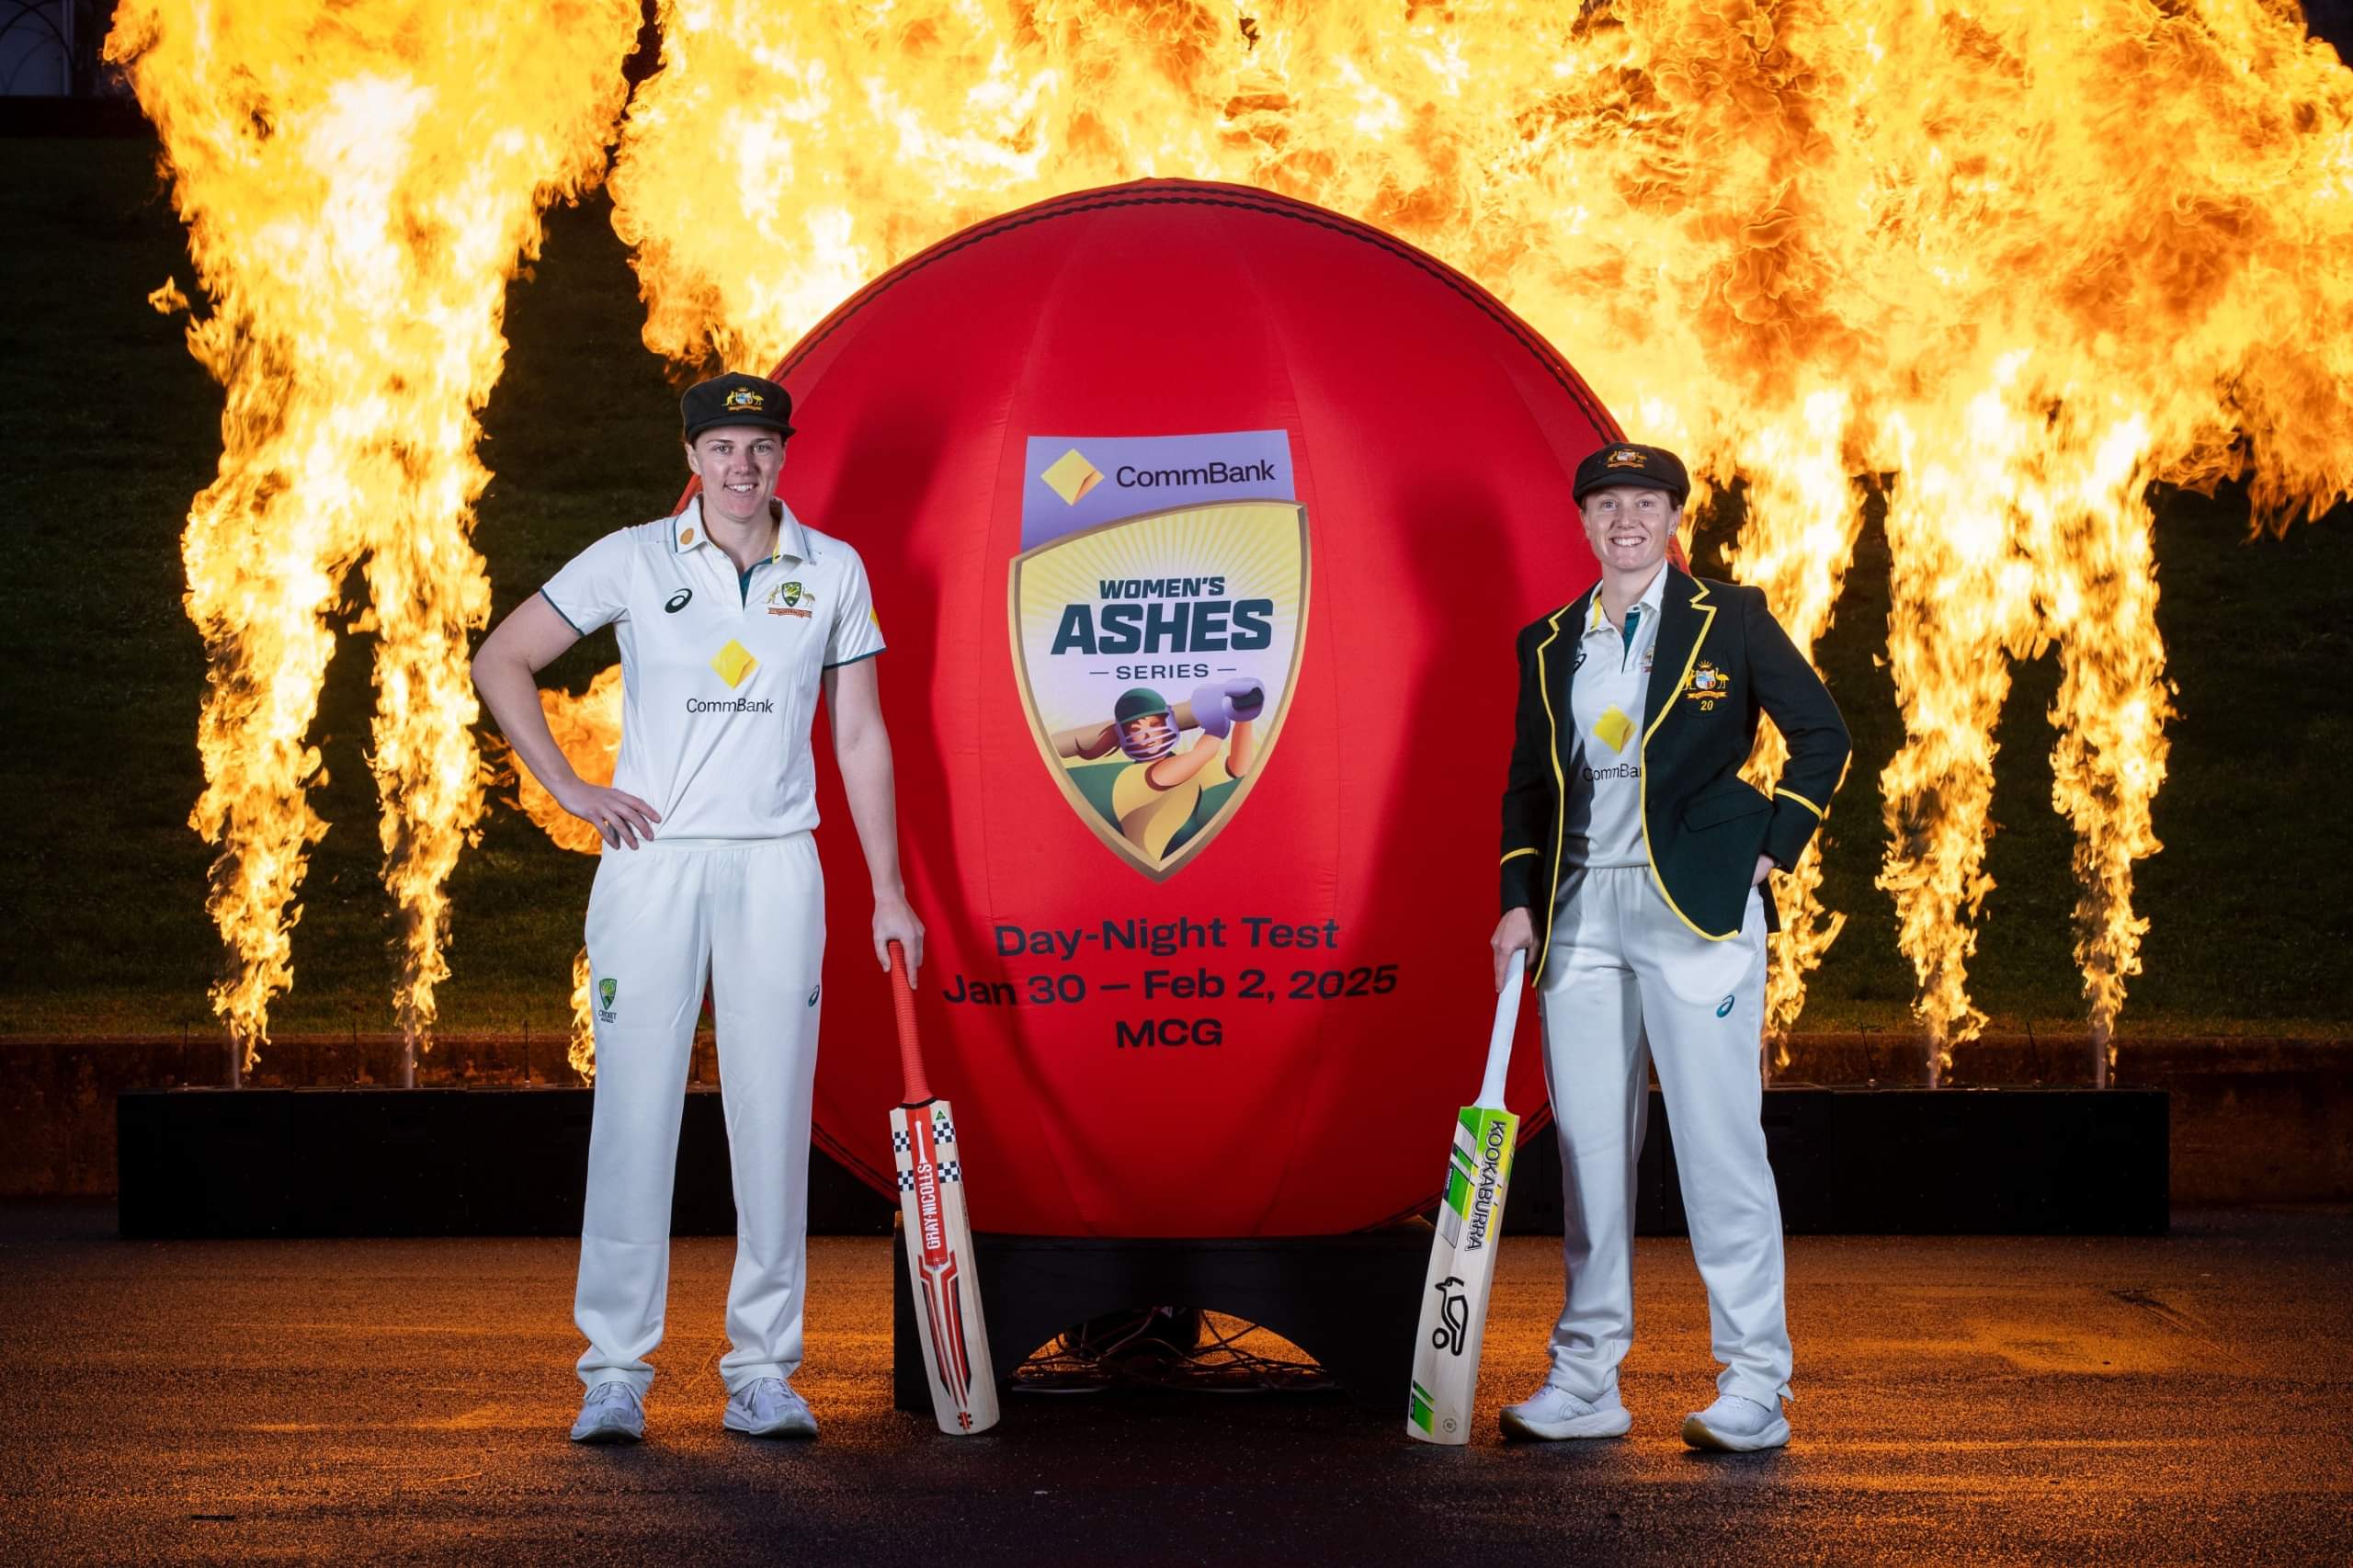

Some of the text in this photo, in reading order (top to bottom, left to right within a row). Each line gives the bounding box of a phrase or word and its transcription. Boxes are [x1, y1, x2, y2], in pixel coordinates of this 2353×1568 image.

[1116, 460, 1276, 487] CommBank
[1099, 576, 1225, 599] WOMEN'S
[1051, 598, 1274, 655] ASHES
[1116, 664, 1209, 679] SERIES
[686, 698, 774, 713] CommBank
[1700, 699, 1714, 710] 20
[995, 917, 1340, 960] Day-Night Test
[942, 974, 1017, 1006] Jan
[1028, 974, 1086, 1004] 30
[1144, 968, 1225, 1000] Feb
[1238, 971, 1275, 1004] 2,
[1289, 964, 1399, 1000] 2025
[1116, 1018, 1223, 1049] MCG
[1464, 1120, 1506, 1251] KOOKABURRA
